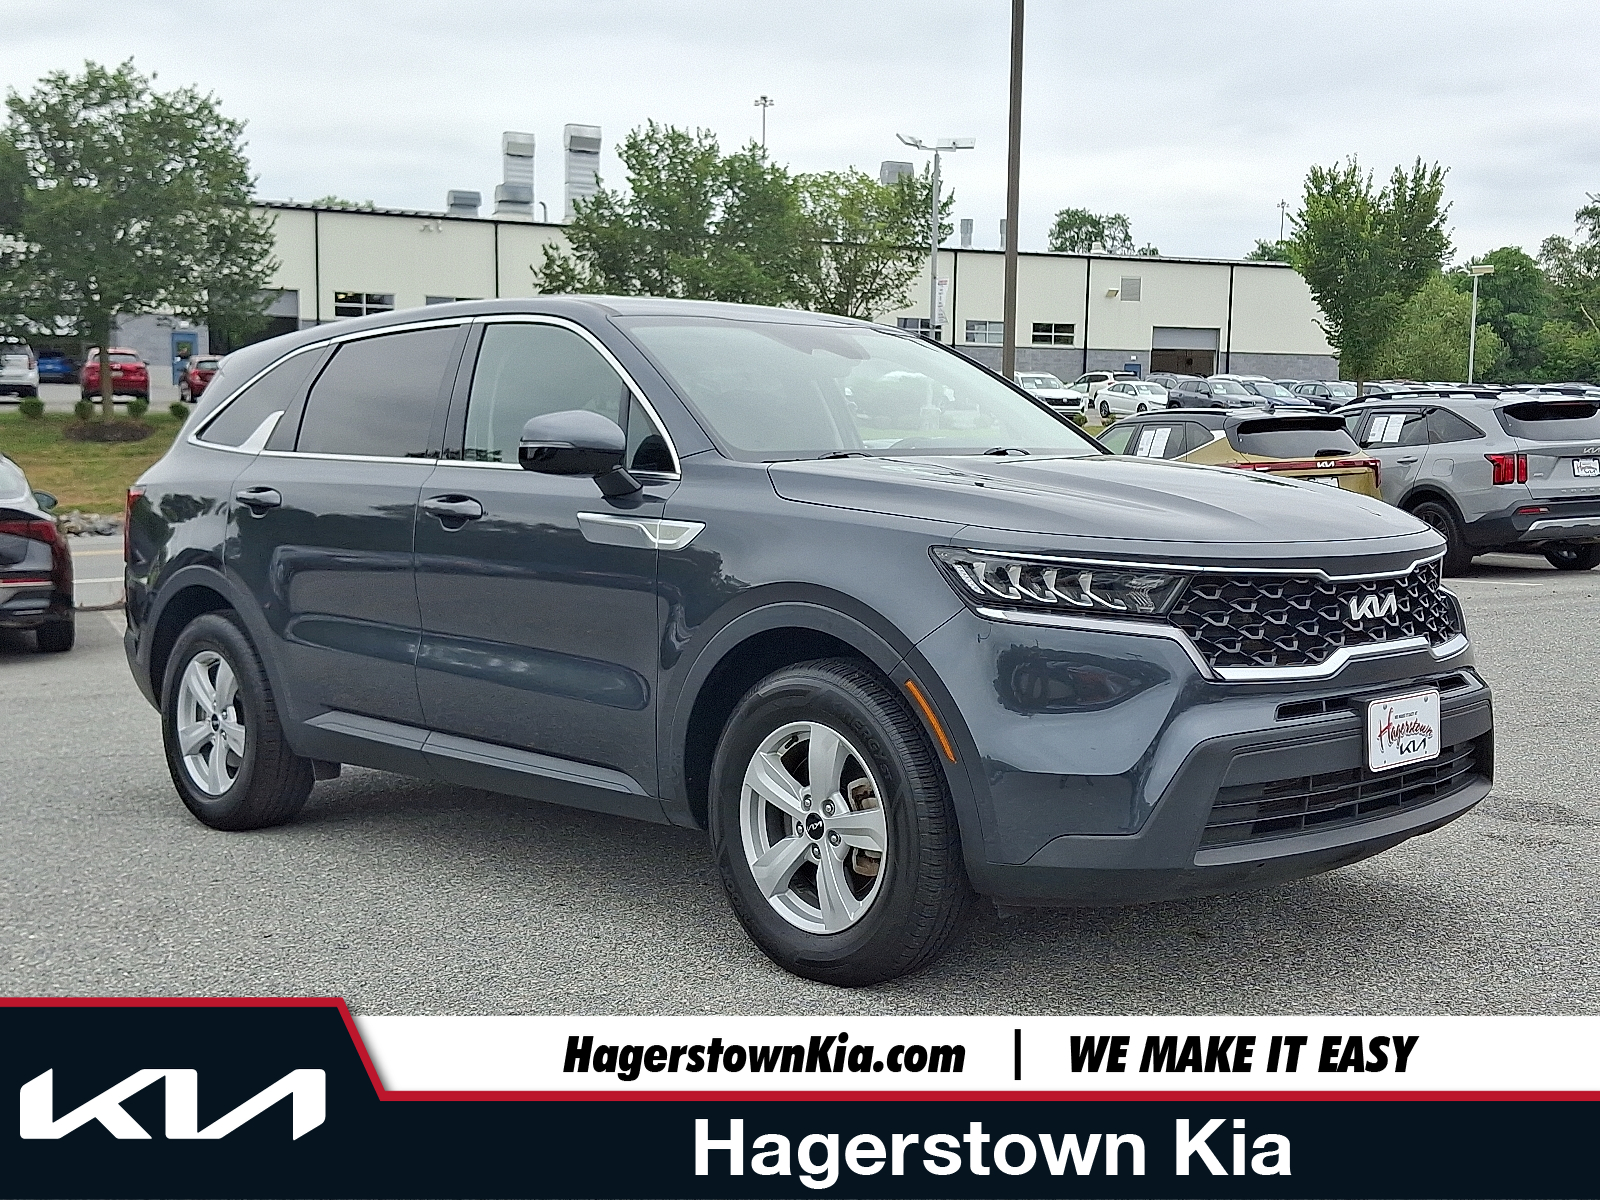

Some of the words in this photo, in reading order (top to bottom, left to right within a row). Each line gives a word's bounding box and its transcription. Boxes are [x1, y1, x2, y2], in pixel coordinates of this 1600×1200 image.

[1316, 460, 1335, 468] KIA
[1349, 593, 1398, 620] KIA
[1377, 707, 1434, 753] Hagerstown
[1399, 737, 1427, 756] KIA
